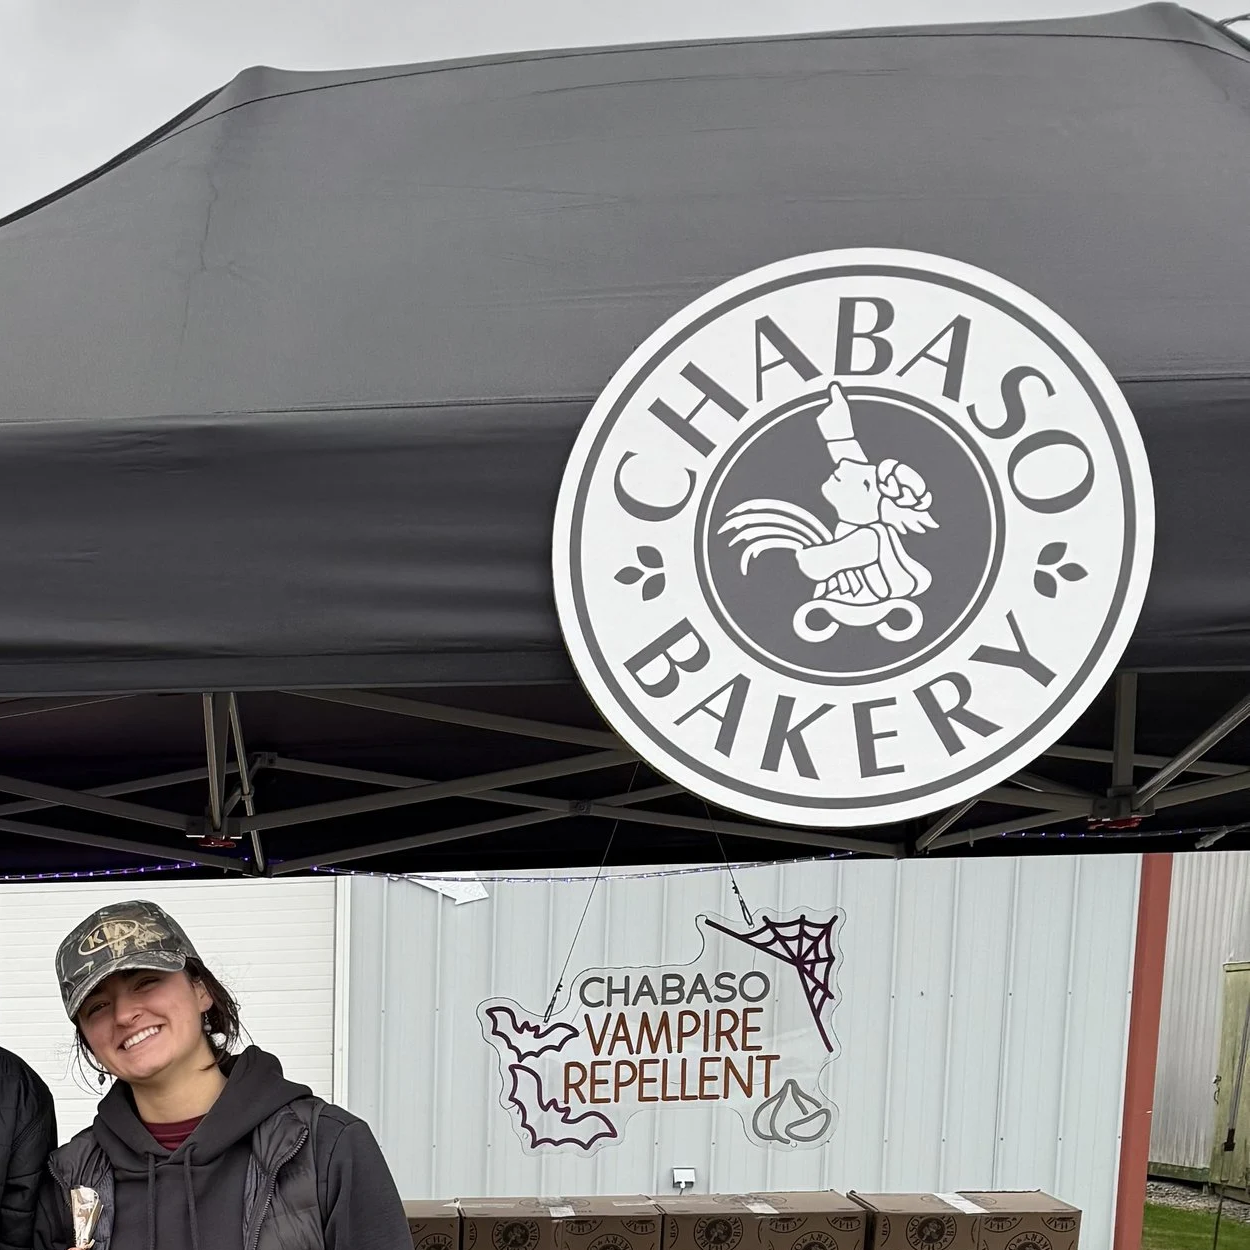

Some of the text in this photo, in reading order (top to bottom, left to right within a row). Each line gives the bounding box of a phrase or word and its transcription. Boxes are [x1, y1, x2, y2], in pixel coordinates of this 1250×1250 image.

[614, 296, 1096, 523] CHABASO
[623, 610, 1057, 780] BAKERY
[579, 971, 771, 1008] CHABASO
[584, 1007, 764, 1056] VAMPIRE
[563, 1054, 781, 1105] REPELLENT
